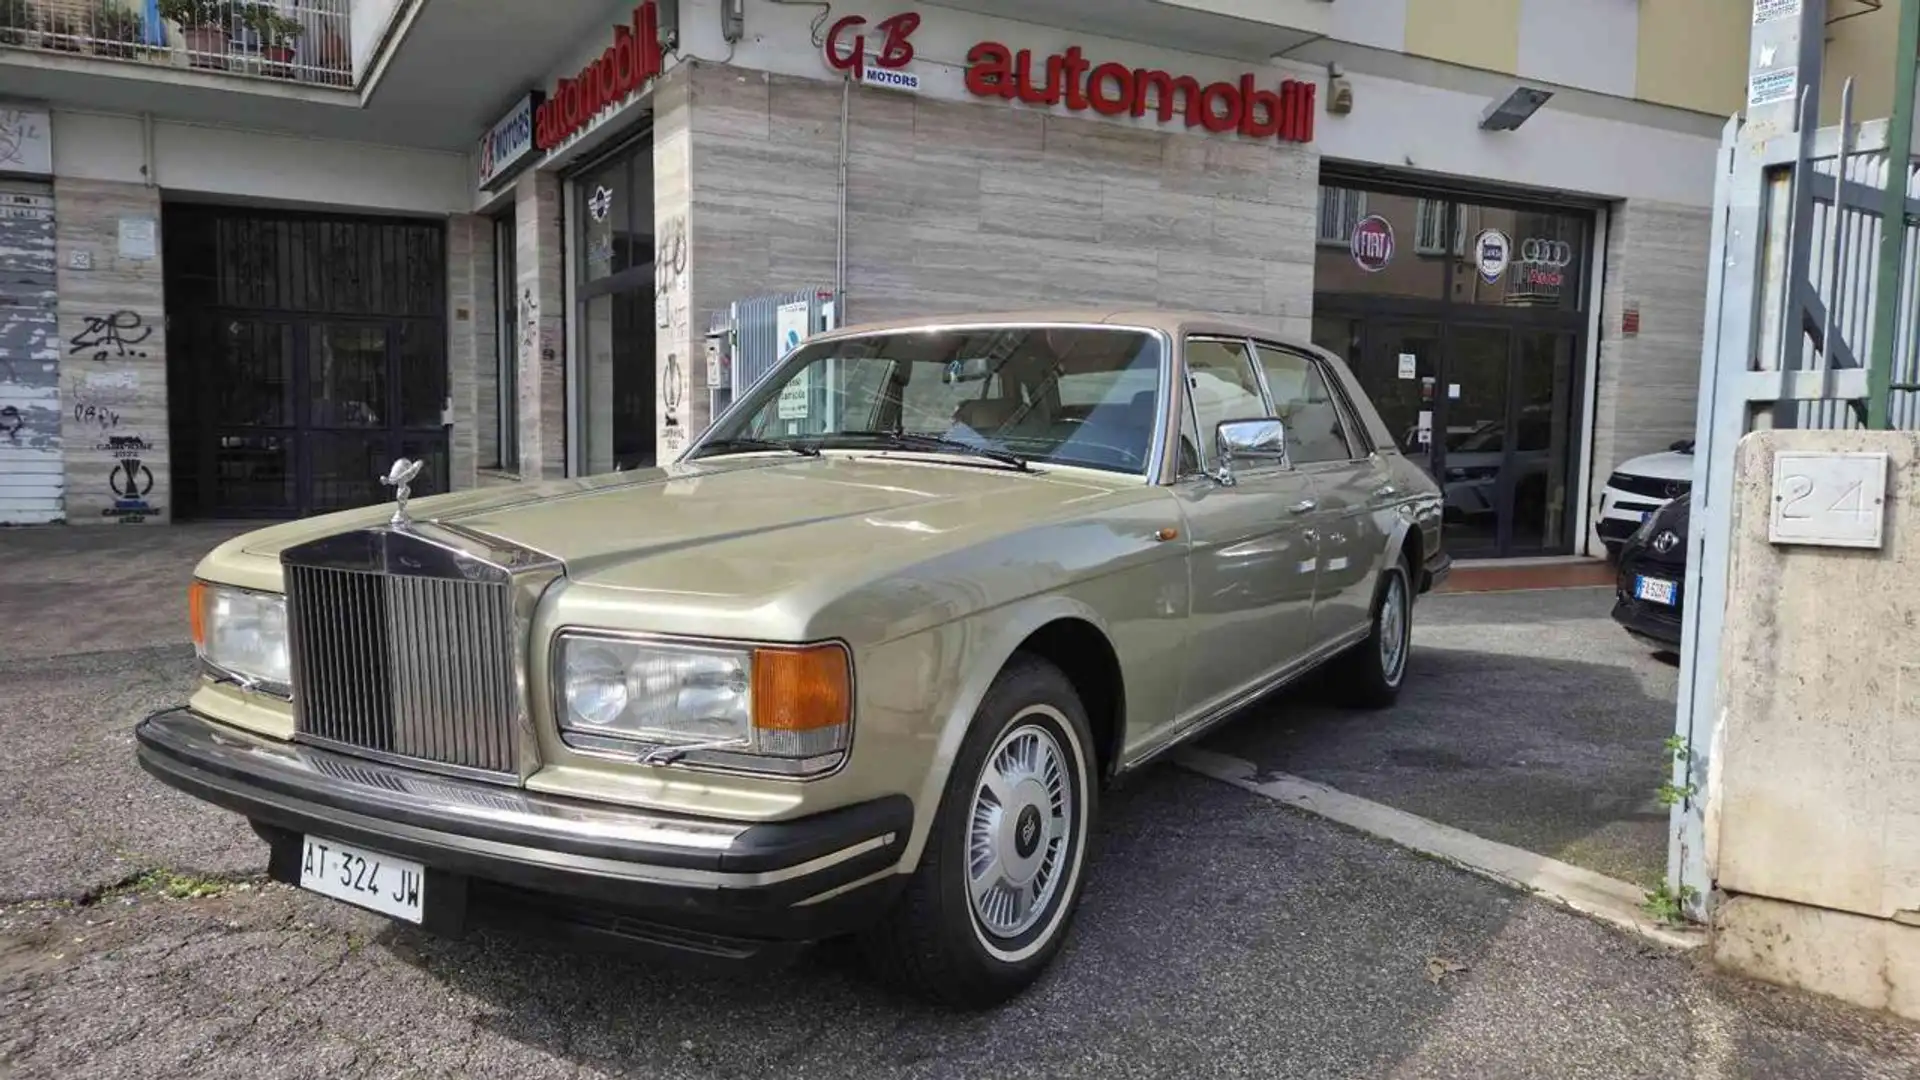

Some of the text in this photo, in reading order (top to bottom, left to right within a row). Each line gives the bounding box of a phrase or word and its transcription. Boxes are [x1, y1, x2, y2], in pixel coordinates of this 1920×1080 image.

[536, 0, 661, 153] automobili
[866, 69, 918, 88] MOTORS
[966, 41, 1316, 143] automobili
[495, 108, 530, 164] MOTORS
[1359, 232, 1386, 260] FIAT
[1782, 473, 1874, 523] 24
[304, 842, 420, 908] AT 324 JW
